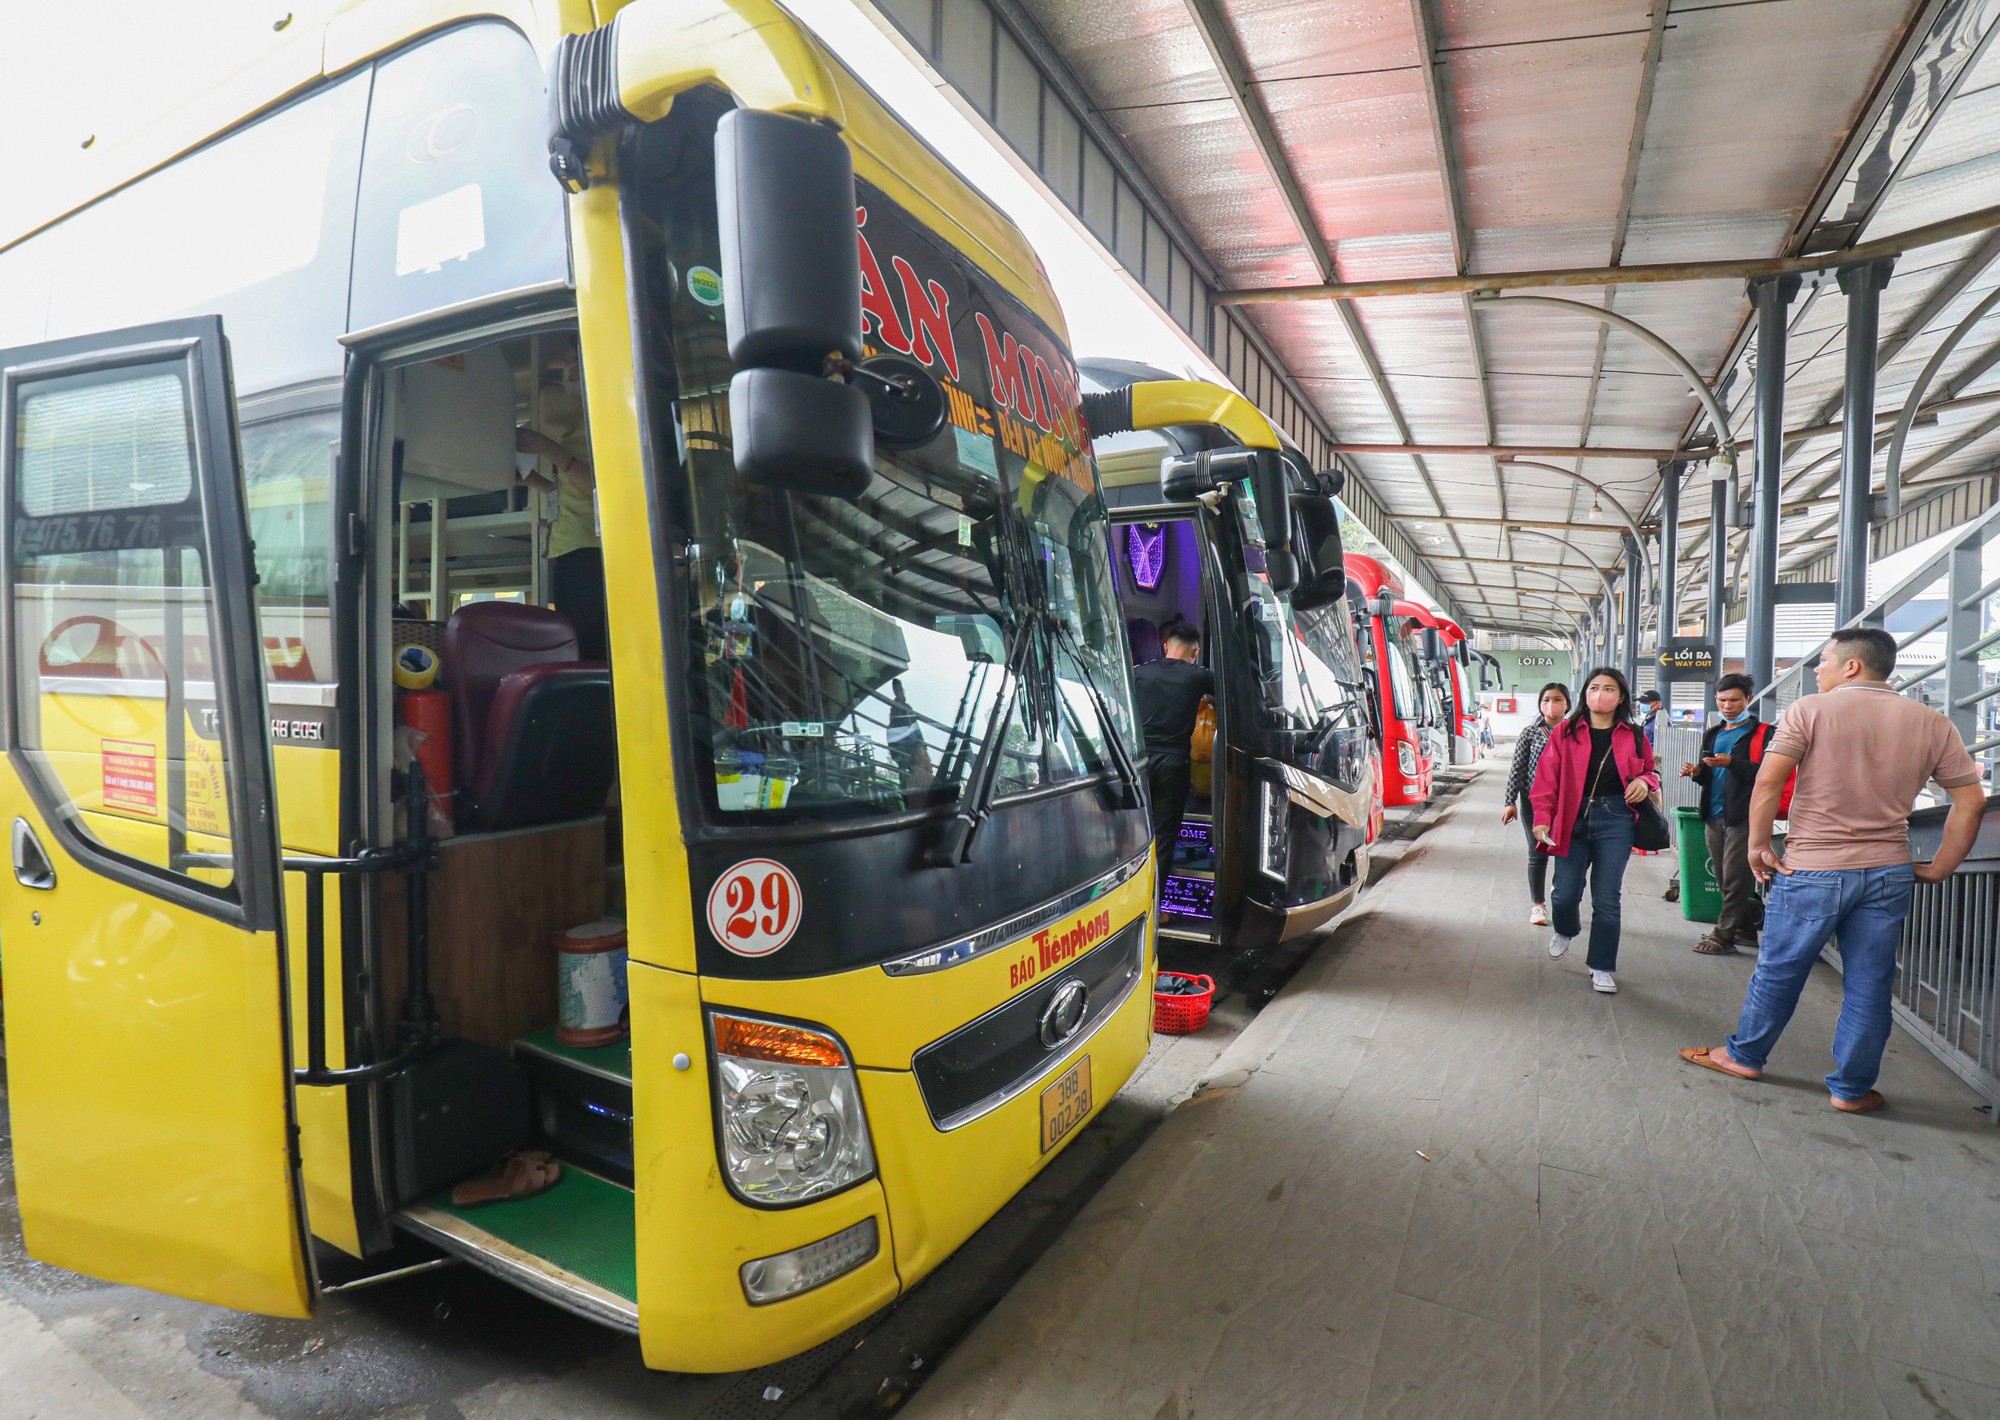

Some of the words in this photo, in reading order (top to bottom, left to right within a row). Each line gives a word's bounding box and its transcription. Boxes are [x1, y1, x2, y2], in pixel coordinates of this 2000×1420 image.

[856, 206, 959, 382] ĂN
[1518, 655, 1536, 666] LỐI
[1538, 657, 1553, 666] RA
[1674, 647, 1693, 660] LỐI
[1696, 651, 1712, 660] RA
[1179, 828, 1208, 840] OME
[725, 872, 791, 940] 29
[1010, 955, 1036, 990] BÁO
[1058, 1069, 1079, 1106] 38B
[1049, 1088, 1088, 1143] 002.28
